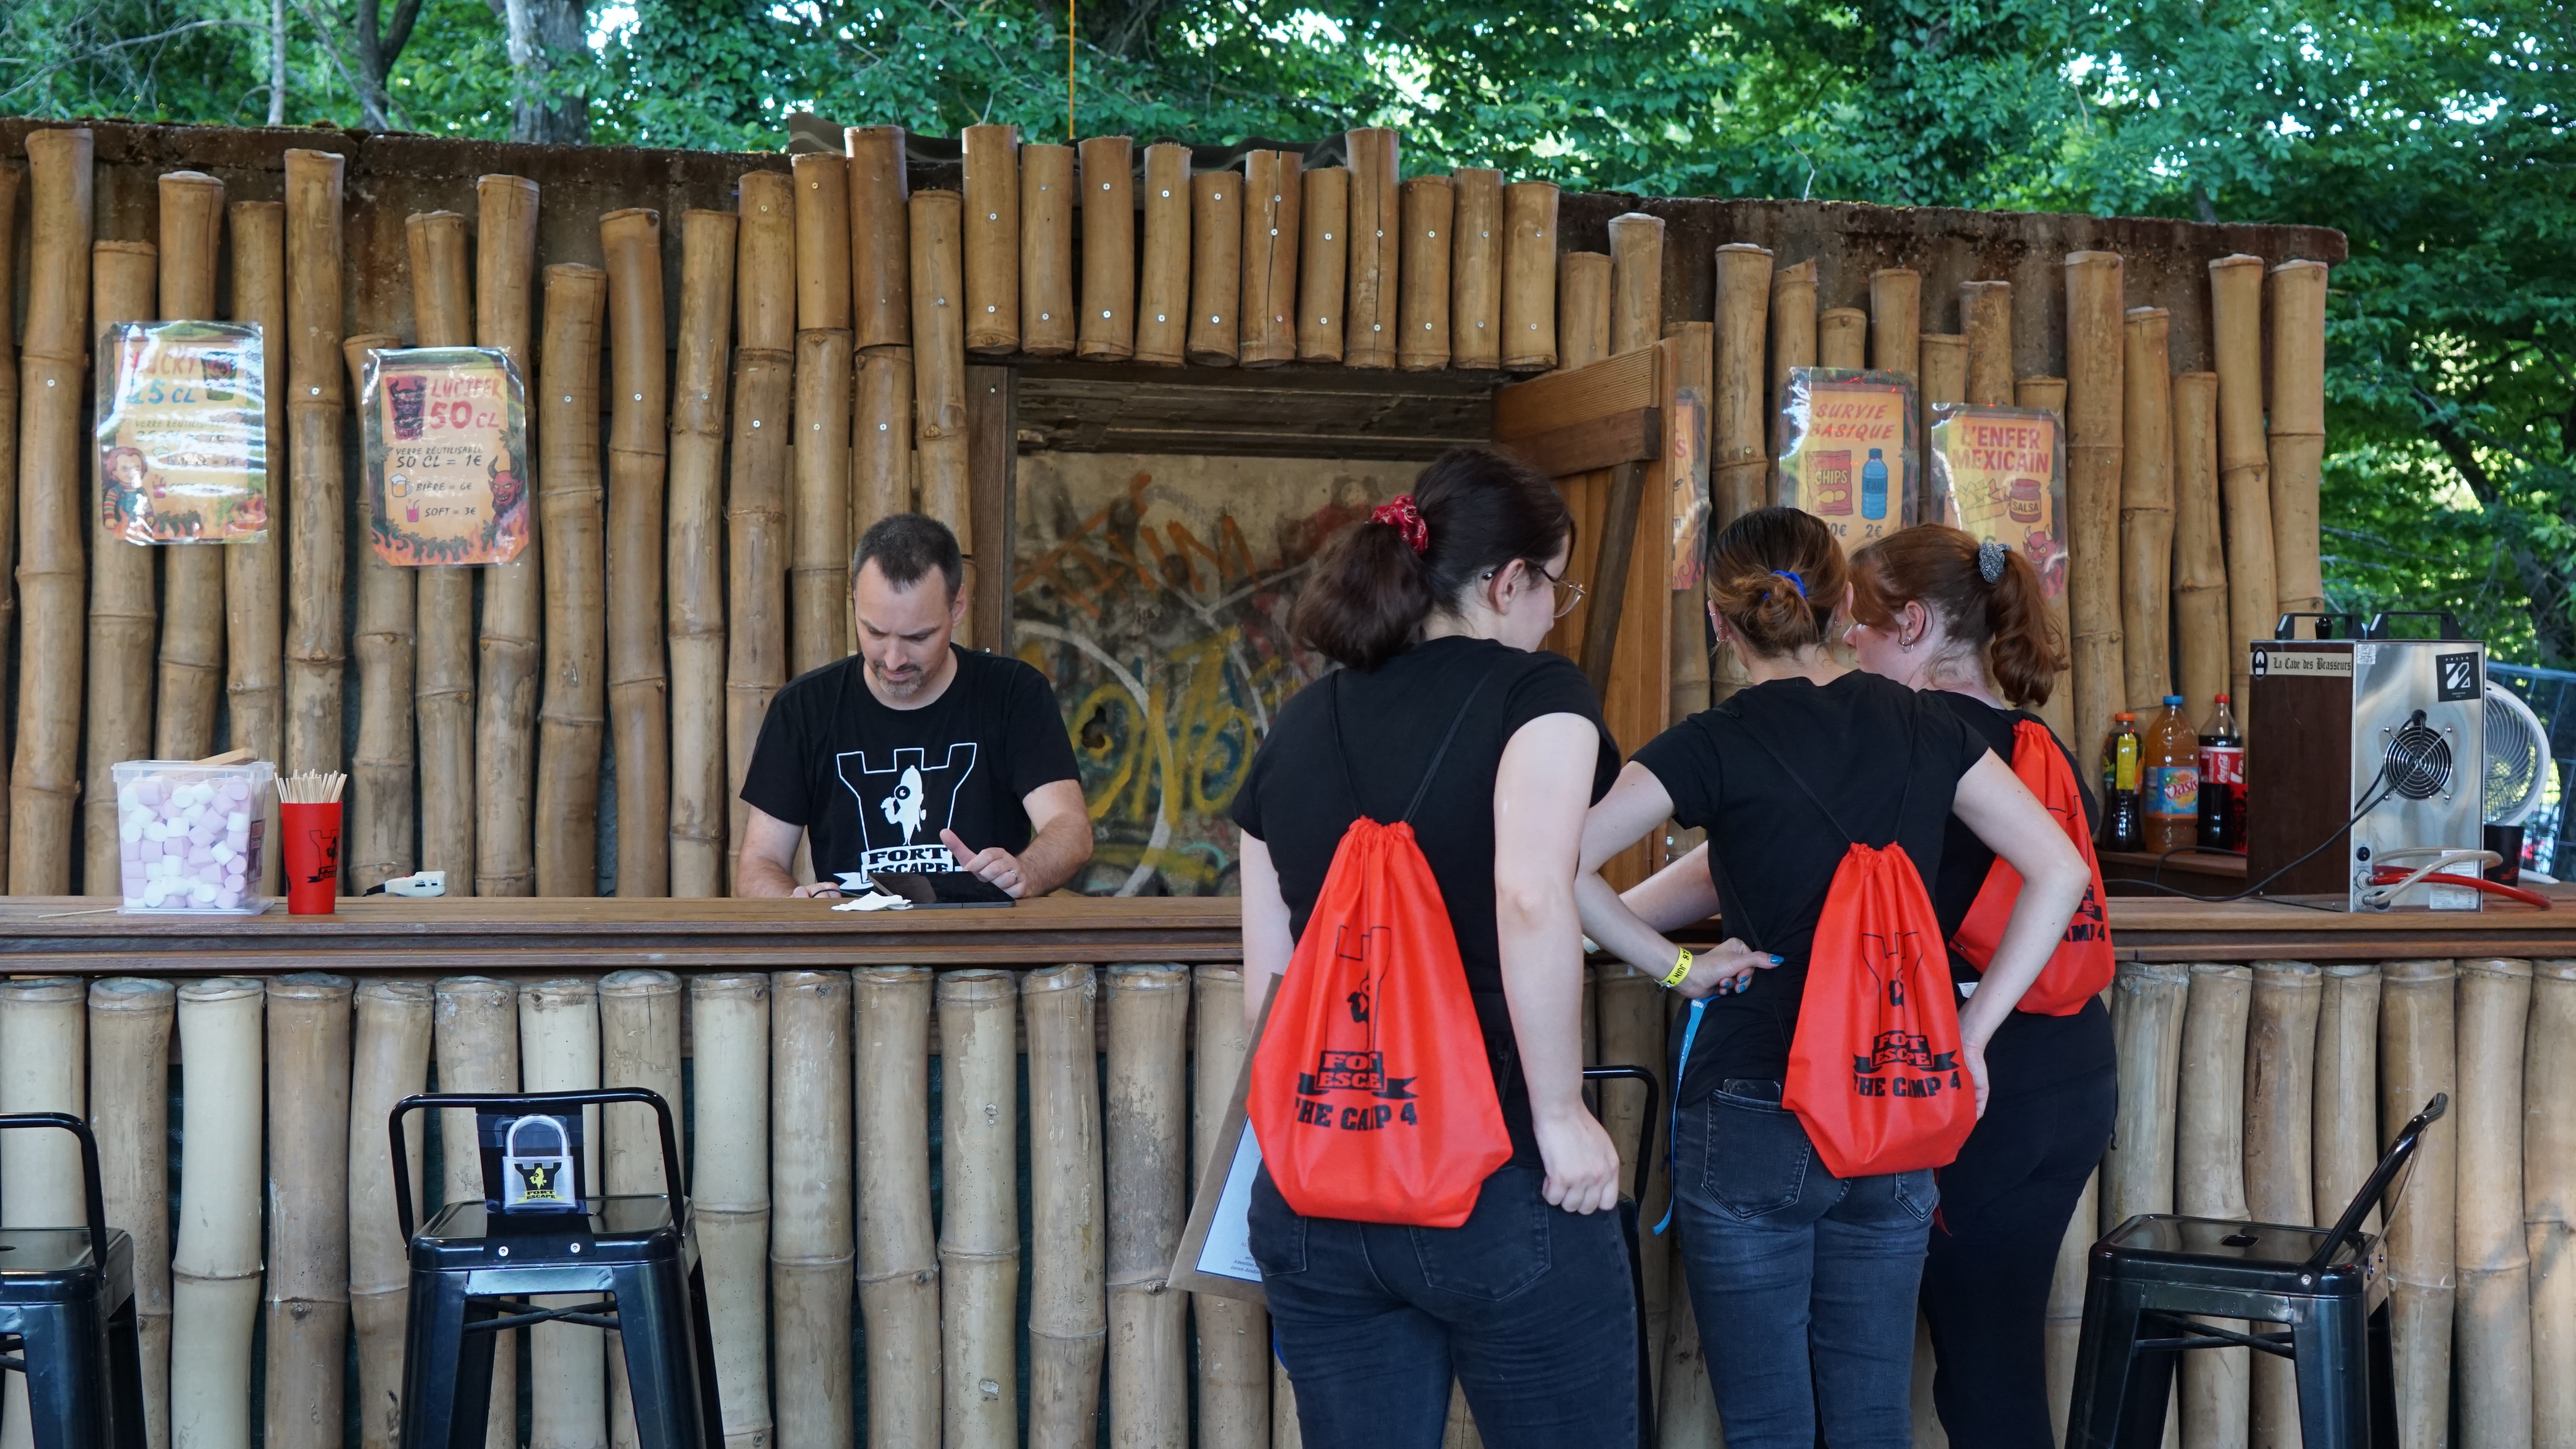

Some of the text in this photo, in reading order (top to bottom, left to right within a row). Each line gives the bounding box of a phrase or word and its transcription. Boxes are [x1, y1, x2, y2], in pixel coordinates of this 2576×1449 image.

[172, 387, 196, 403] CL
[431, 378, 503, 400] LUCIFER
[430, 400, 499, 429] 50 CL
[1816, 404, 1889, 420] SURVIE
[135, 419, 163, 428] VERRE
[1809, 423, 1895, 442] BASIQUE
[1960, 425, 2041, 449] L'ENFER
[396, 455, 416, 468] 50
[422, 455, 440, 467] CL
[465, 454, 483, 467] 1€
[1951, 449, 2050, 473] MEXICAIN
[416, 481, 445, 491] BIÈRE
[460, 482, 472, 491] 6€
[1814, 469, 1848, 486] CHIPS
[424, 507, 450, 517] SOFT
[465, 507, 477, 515] 3€
[2012, 500, 2039, 512] SALSA
[1827, 521, 1883, 537] 0€ 2€
[2273, 657, 2351, 671] La Cave des Brasseurs
[2165, 778, 2199, 799] Oasis
[868, 847, 948, 864] FORT
[2097, 924, 2105, 942] 4
[1682, 949, 1689, 961] 28
[1673, 964, 1686, 978] JUIN
[1877, 1034, 1925, 1051] FOT
[1875, 1048, 1930, 1067] ESCPE
[1949, 1070, 1961, 1090] 4
[1295, 1097, 1333, 1128] HE
[1400, 1102, 1418, 1126] 4
